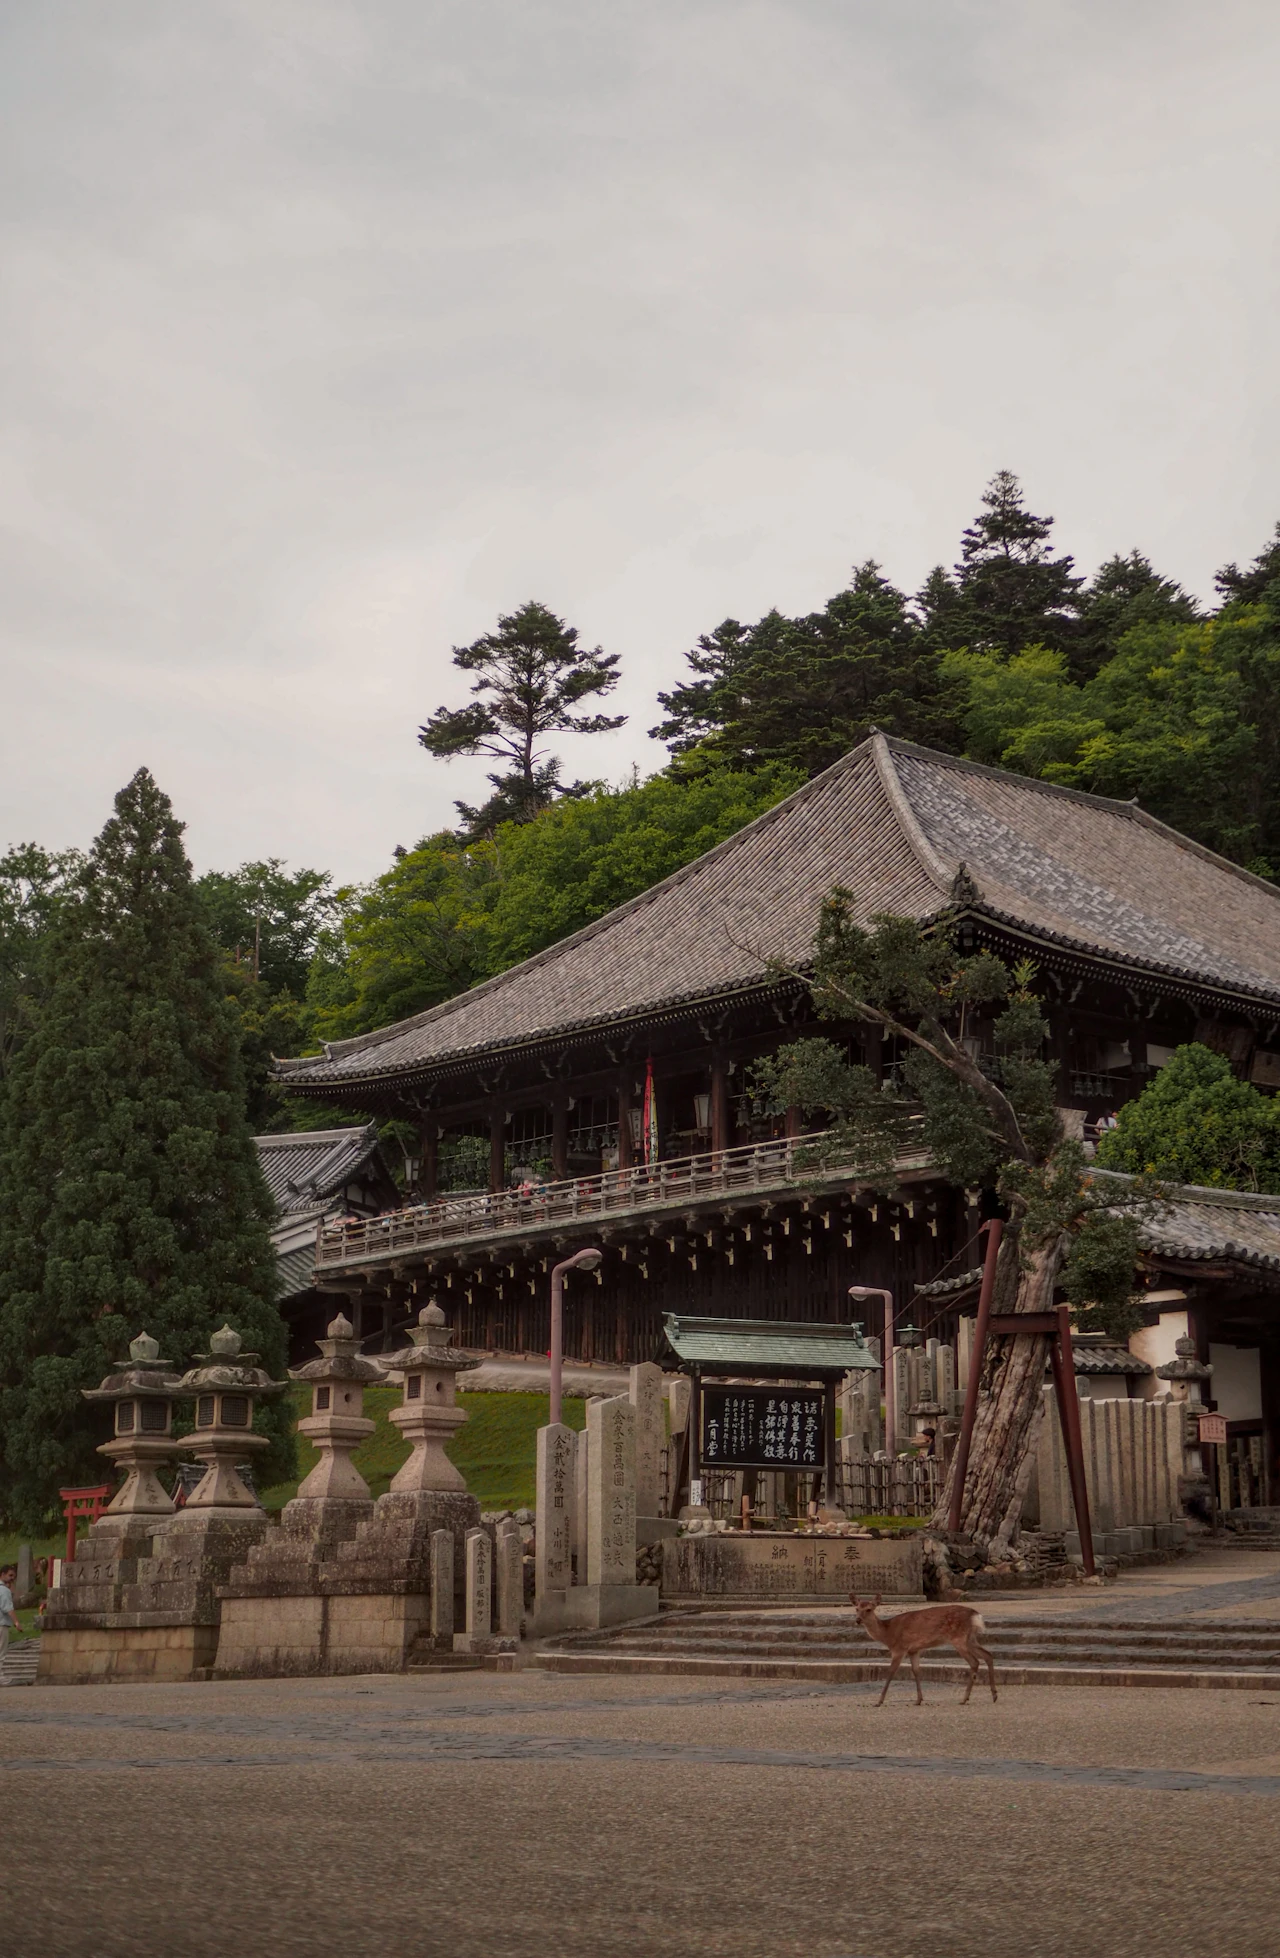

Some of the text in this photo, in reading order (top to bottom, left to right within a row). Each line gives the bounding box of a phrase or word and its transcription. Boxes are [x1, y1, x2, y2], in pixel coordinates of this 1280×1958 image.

[707, 1419, 719, 1456] 二月堂
[771, 1544, 788, 1559] 納
[844, 1546, 861, 1562] 奉
[817, 1549, 827, 1580] 二月堂
